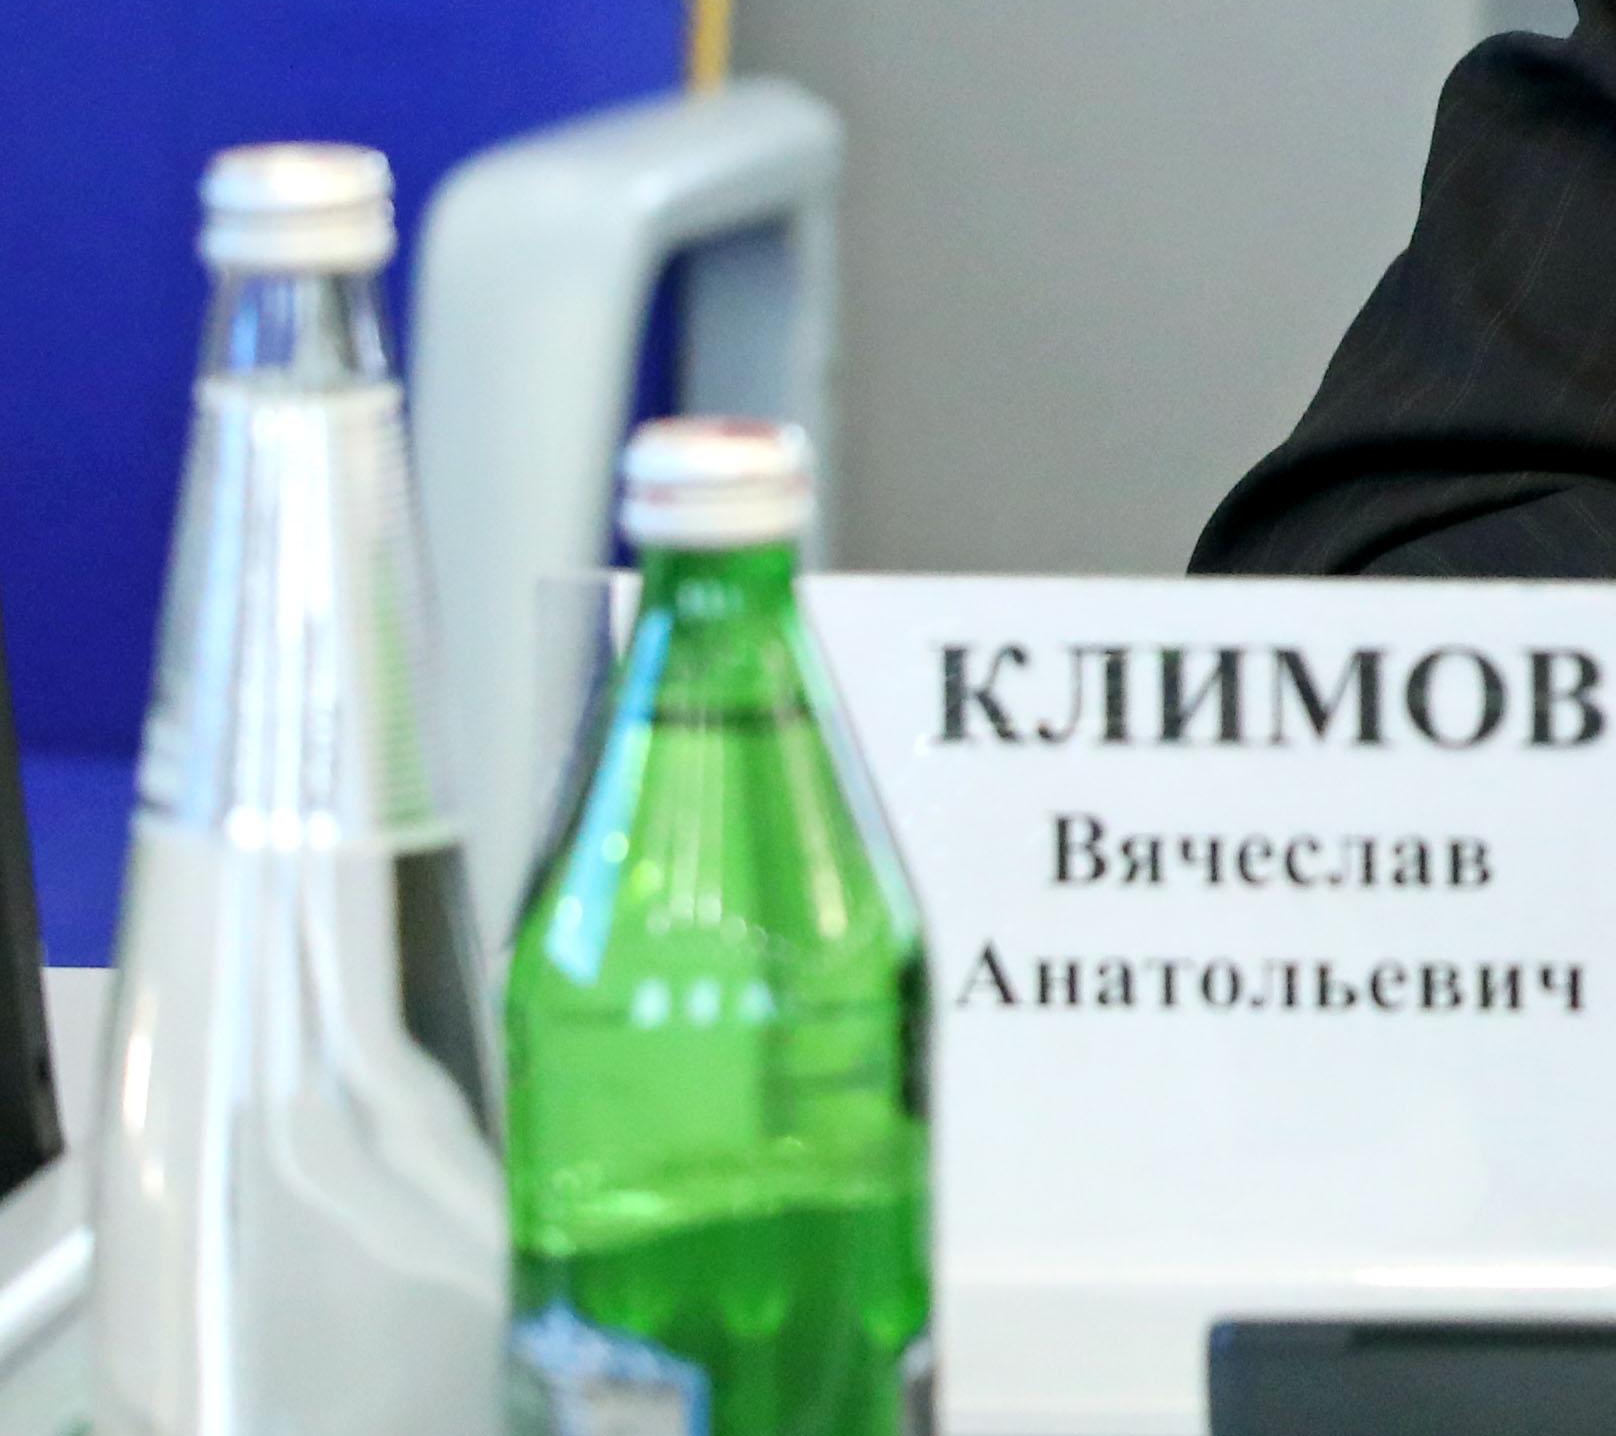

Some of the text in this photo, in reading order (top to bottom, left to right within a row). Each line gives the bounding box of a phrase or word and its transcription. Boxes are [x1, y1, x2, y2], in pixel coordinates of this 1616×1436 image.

[938, 643, 1608, 749] КЛИМОВ
[1051, 814, 1493, 888] Вячеслав
[953, 942, 1585, 1014] Анатольевич
